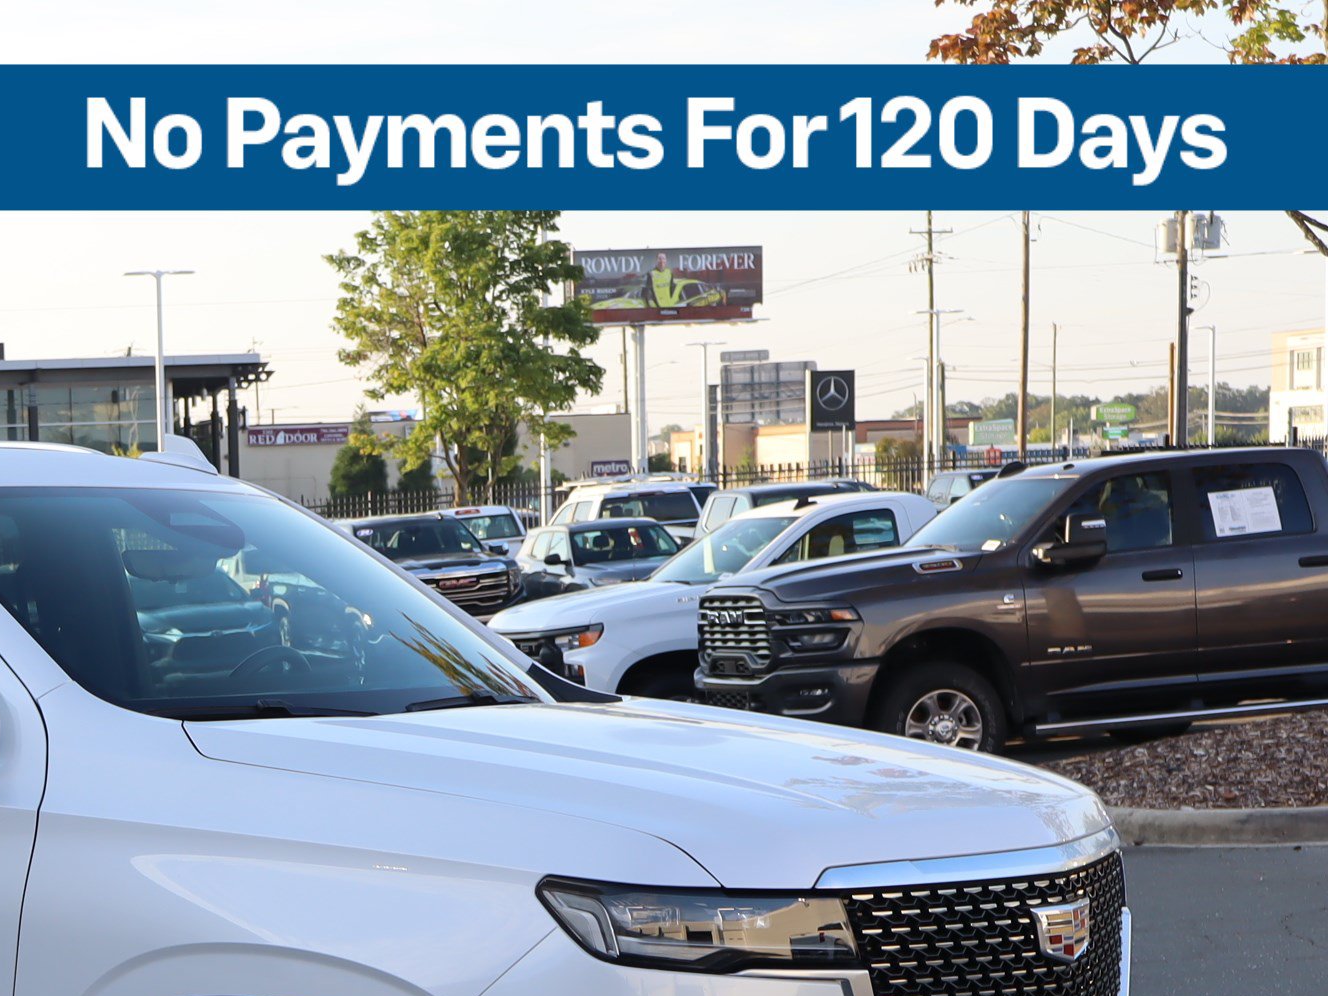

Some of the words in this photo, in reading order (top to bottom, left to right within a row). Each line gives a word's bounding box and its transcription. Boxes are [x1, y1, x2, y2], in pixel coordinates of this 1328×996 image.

[581, 256, 644, 274] ROWDY
[678, 252, 755, 272] FOREVER
[249, 434, 275, 445] RED
[286, 433, 318, 444] DOOR
[593, 462, 628, 473] metro
[707, 609, 743, 624] RAM
